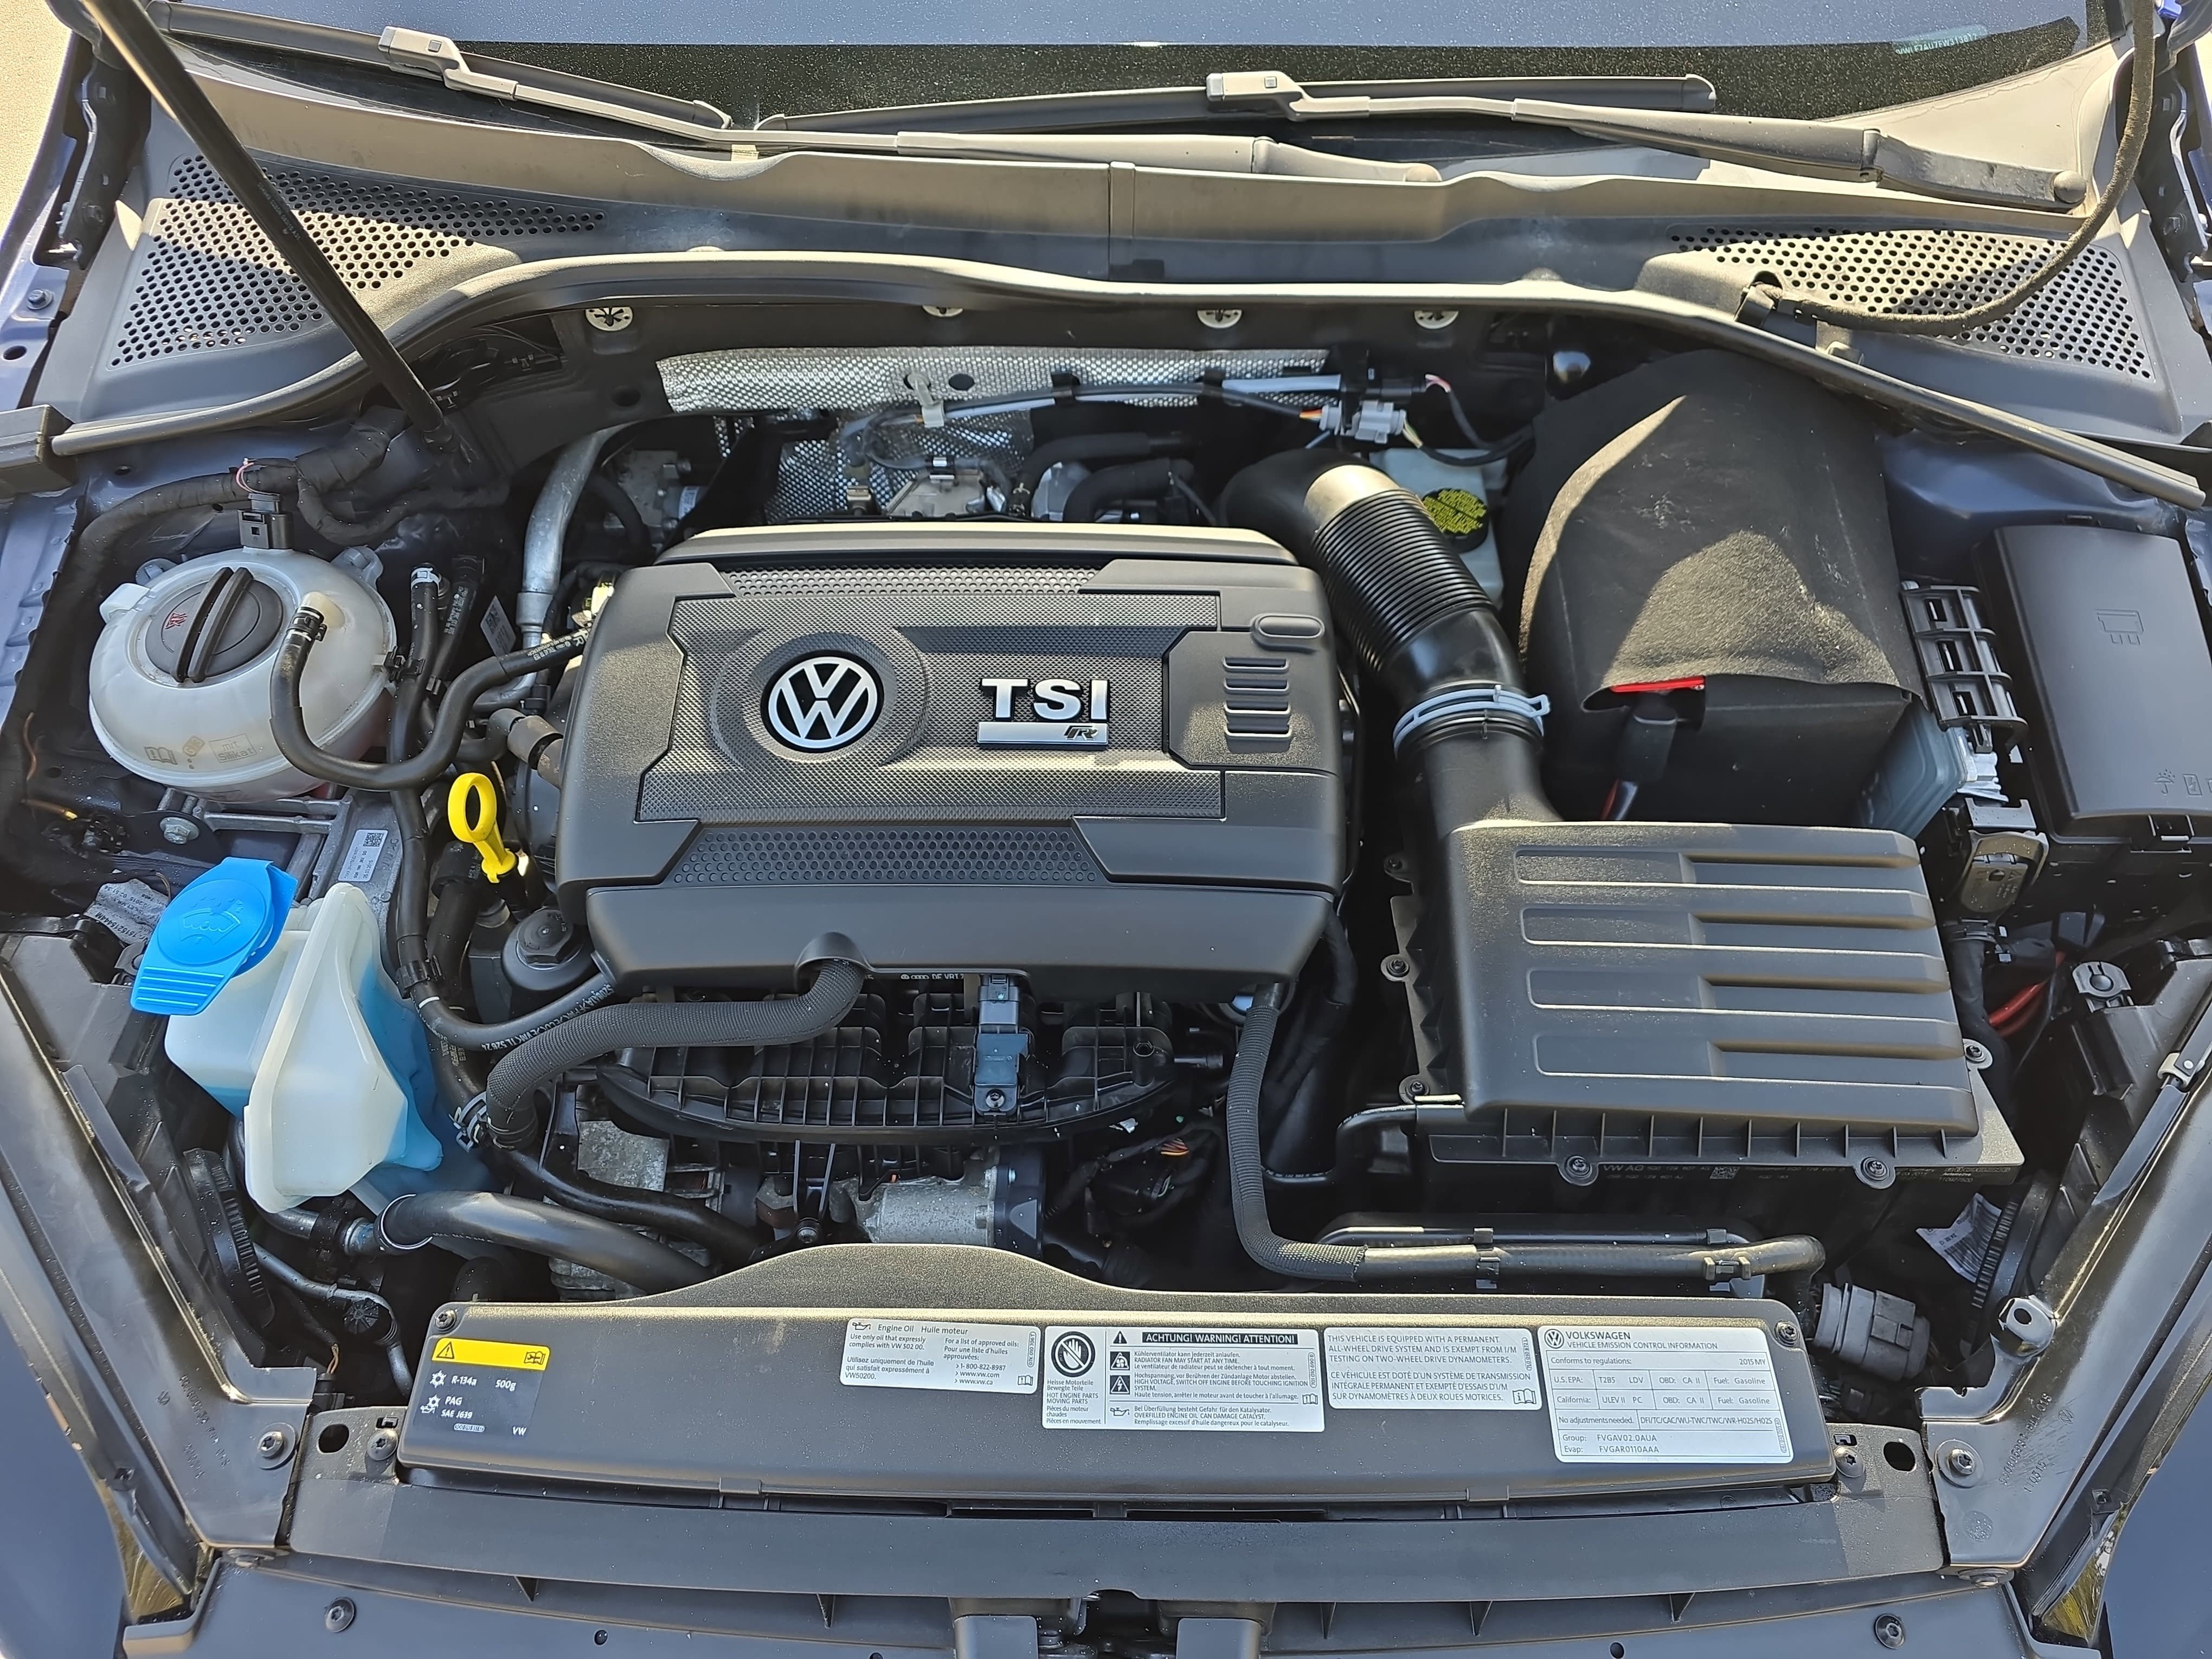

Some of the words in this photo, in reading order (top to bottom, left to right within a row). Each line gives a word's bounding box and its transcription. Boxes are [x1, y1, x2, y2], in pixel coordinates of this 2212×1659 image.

[980, 678, 1109, 722] TSI
[222, 740, 239, 751] mit
[218, 748, 254, 761] Silikat
[878, 1324, 902, 1333] Engine
[1146, 1333, 1192, 1342] ACHTUNG!
[1195, 1334, 1240, 1342] WARNING!
[1243, 1334, 1294, 1343] ATTENTION!
[1565, 1331, 1630, 1340] VOLKSWAGEN
[1341, 1370, 1377, 1379] VÉHICULE
[1378, 1371, 1390, 1379] EST
[1392, 1371, 1411, 1379] DOTÉ
[1432, 1371, 1464, 1379] SYSTÈME
[451, 1375, 477, 1386] R-134a
[495, 1379, 517, 1392] 500g
[1332, 1381, 1370, 1389] INTÉGRALE
[1371, 1381, 1414, 1390] PERMANENT
[1425, 1381, 1457, 1390] EXEMPTÉ
[1332, 1391, 1347, 1399] SUR
[1348, 1391, 1409, 1400] DYNAMOMÈTRES
[1410, 1392, 1416, 1400] À
[445, 1396, 462, 1405] PAG
[441, 1409, 454, 1417] SAE
[456, 1411, 473, 1419] J639
[512, 1426, 527, 1436] VW
[1562, 1434, 1586, 1443] Group:
[1564, 1445, 1583, 1454] Evap:
